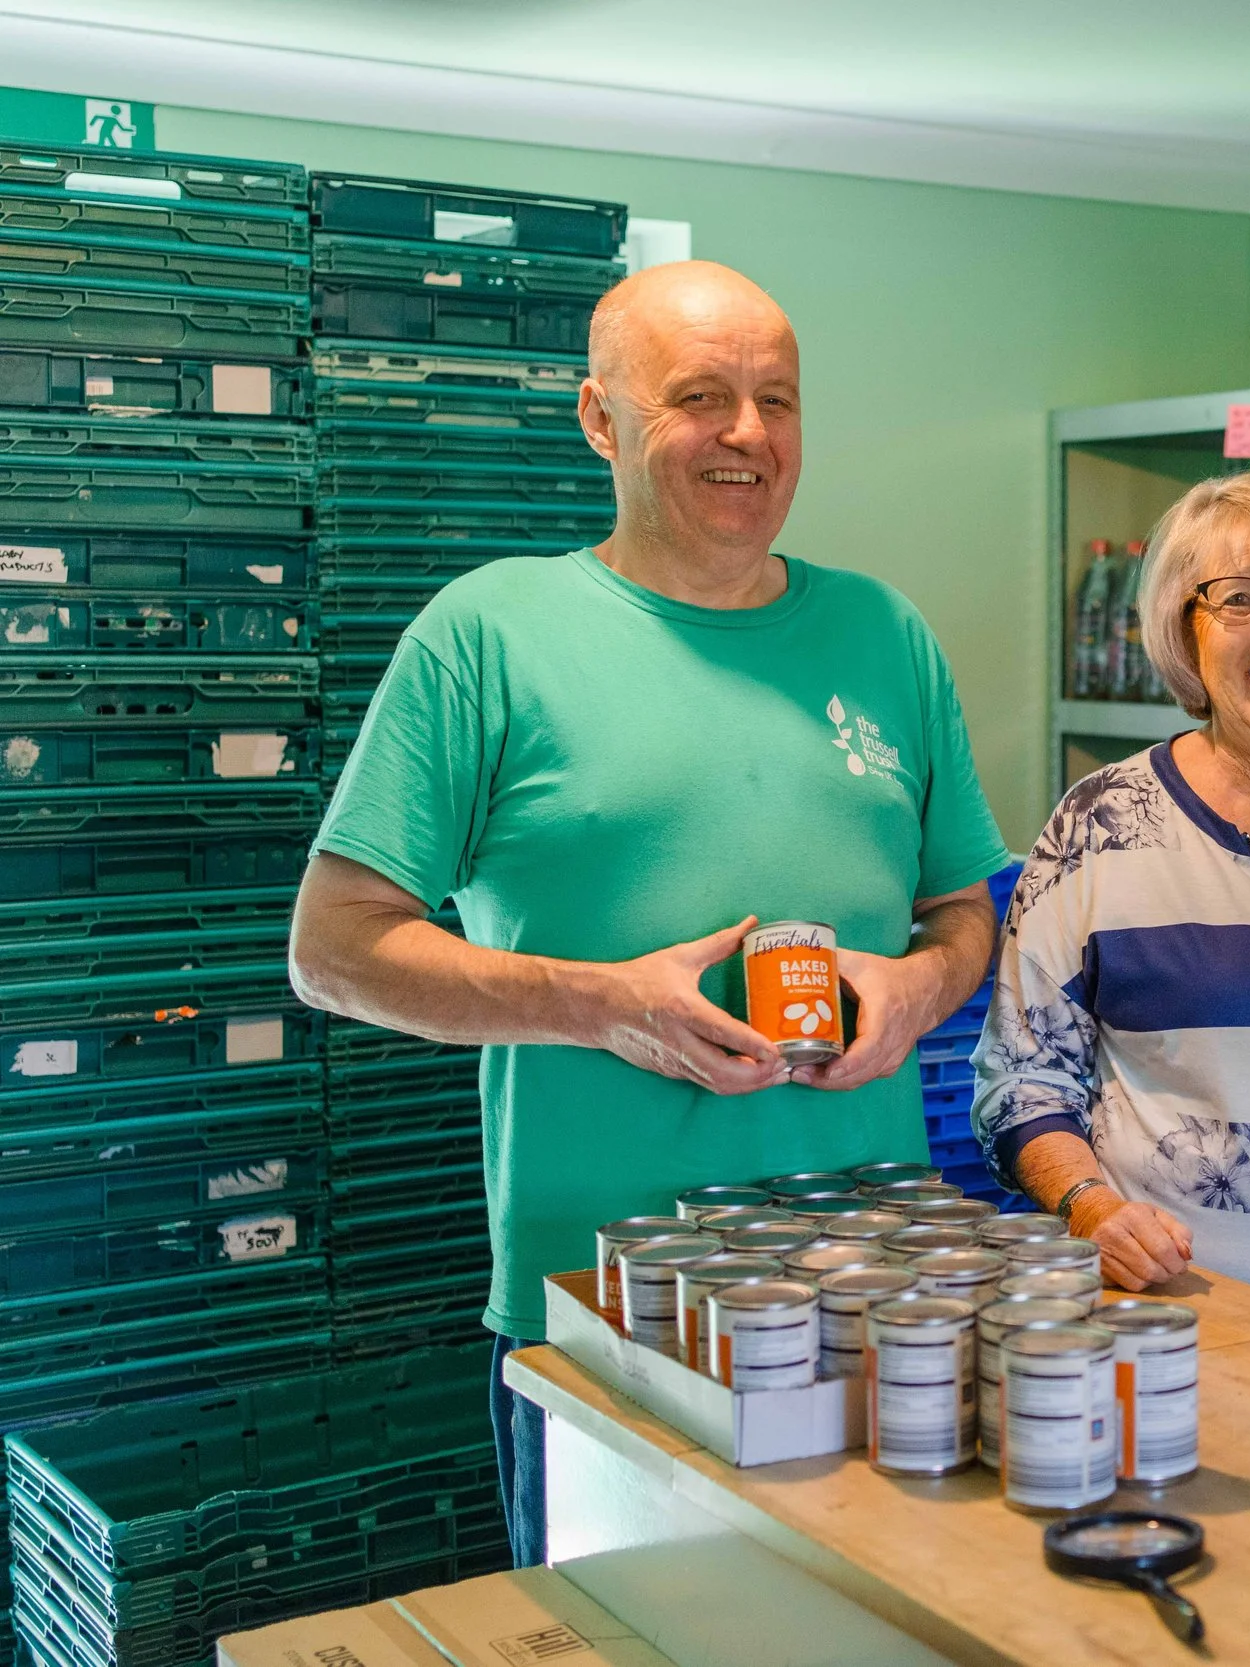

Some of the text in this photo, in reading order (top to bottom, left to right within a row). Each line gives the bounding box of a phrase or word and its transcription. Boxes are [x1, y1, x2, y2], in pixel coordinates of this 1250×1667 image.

[856, 715, 880, 738] the
[859, 731, 899, 762] trussell
[754, 928, 824, 957] Essentials
[780, 959, 829, 974] BAKED
[781, 973, 830, 988] BEANS
